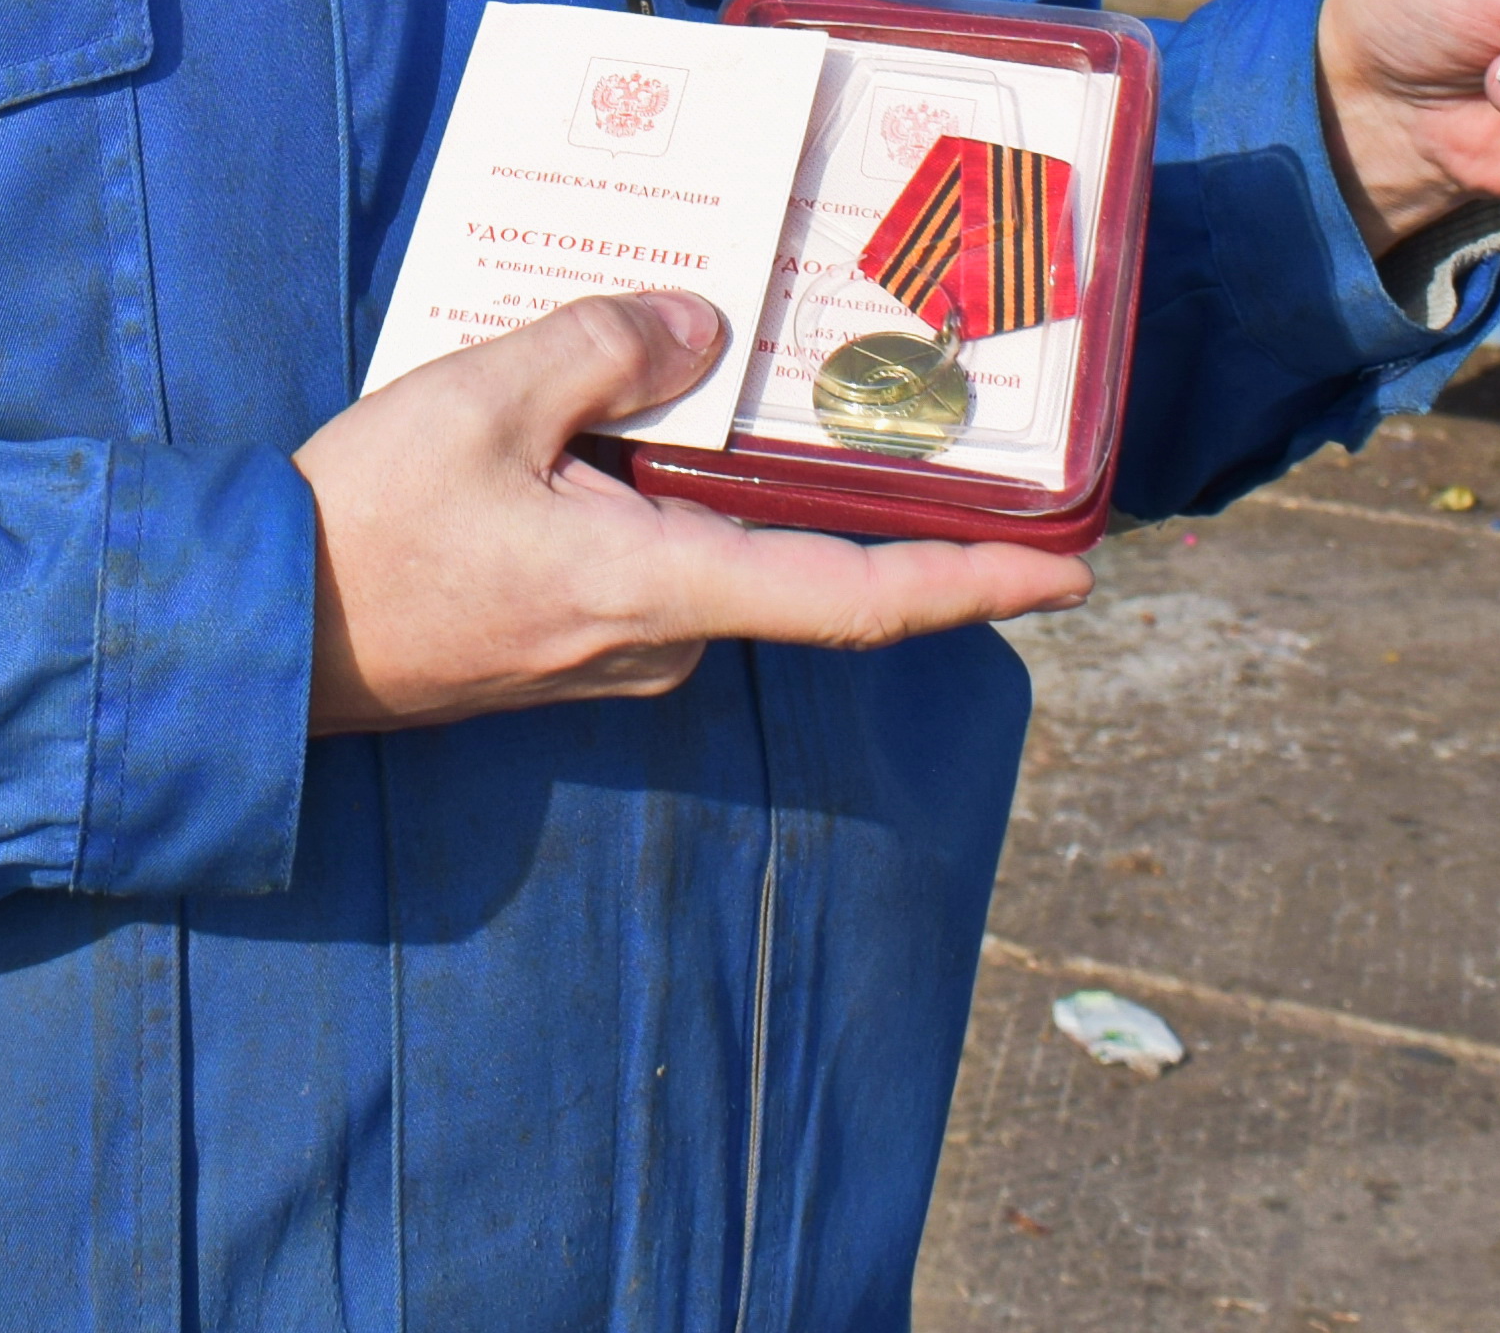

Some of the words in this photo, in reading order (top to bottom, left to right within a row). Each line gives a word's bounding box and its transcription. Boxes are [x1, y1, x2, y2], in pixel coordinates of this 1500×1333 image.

[491, 165, 608, 190] РОССИЙСКАЯ
[614, 180, 721, 207] ФЕДЕРАЦИЯ
[466, 222, 711, 270] УДОСТОВЕРЕНИЕ
[477, 257, 488, 269] К
[495, 259, 604, 284] ЮБИЛЕЙНОЙ
[429, 306, 440, 318] В
